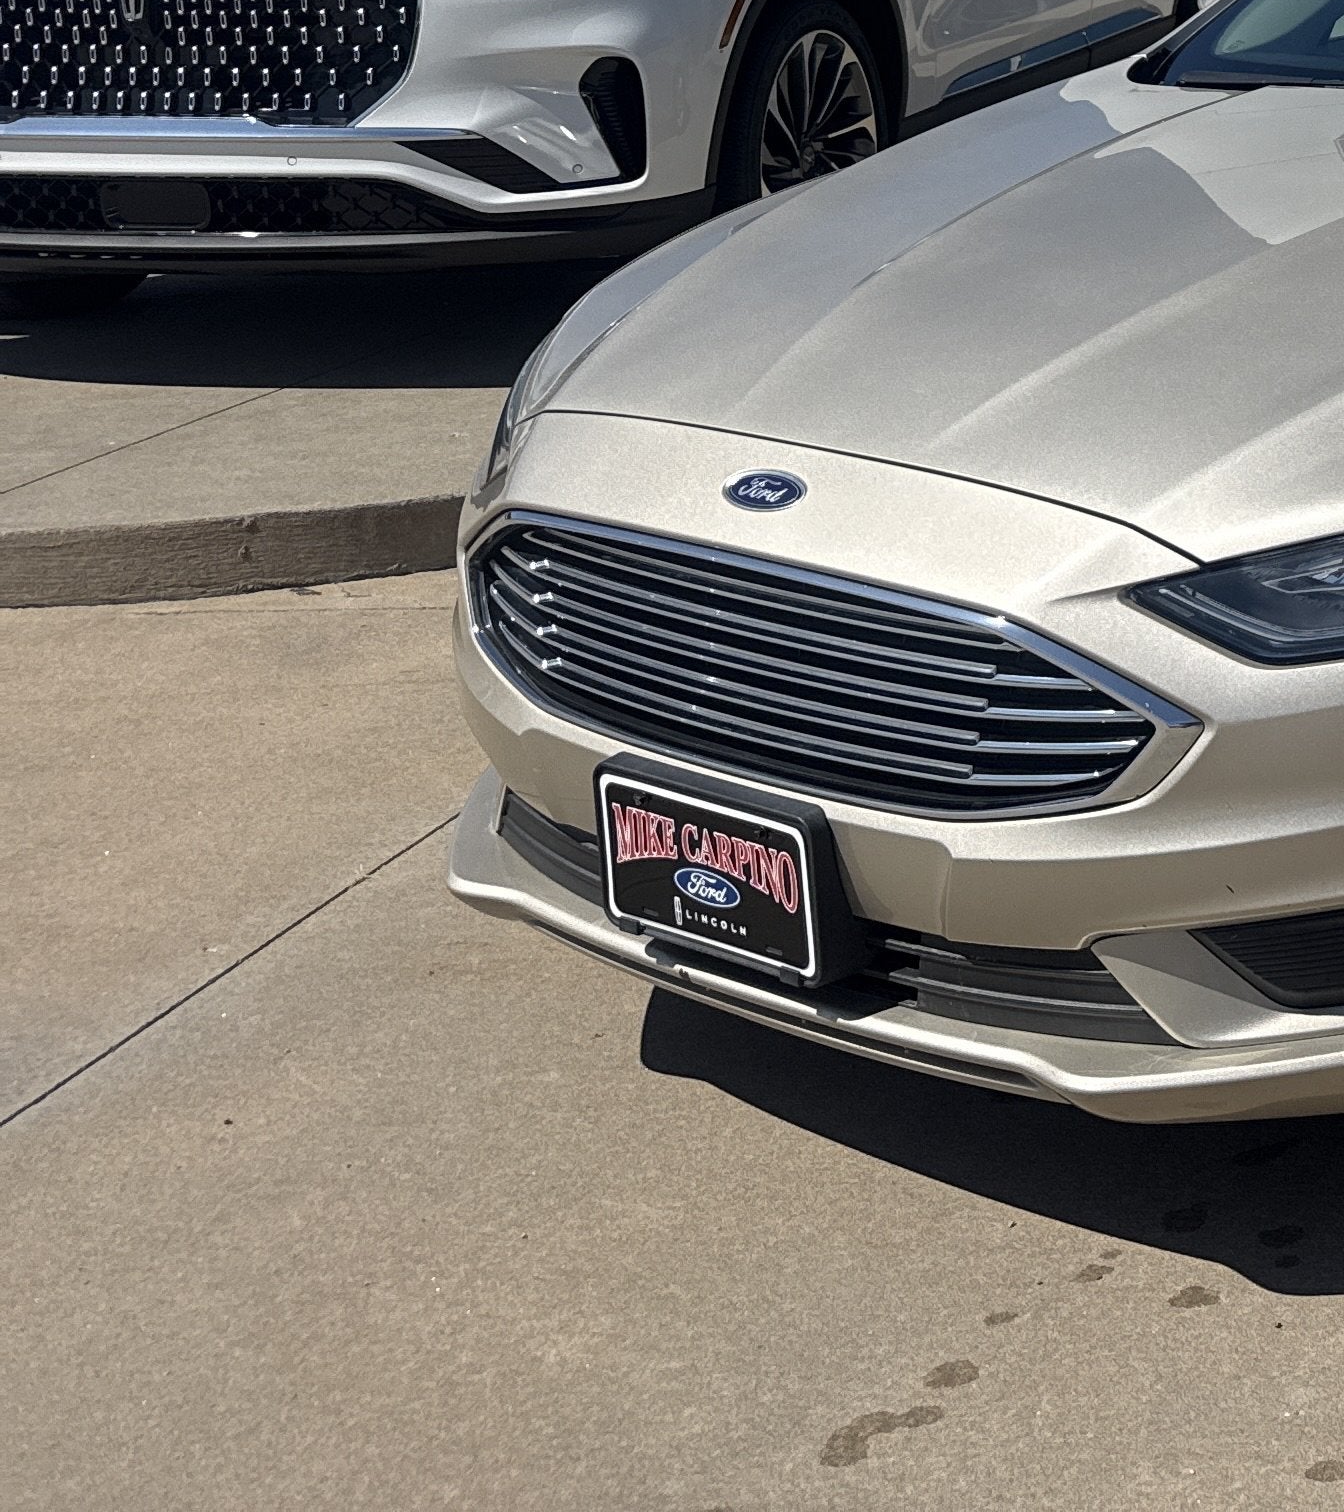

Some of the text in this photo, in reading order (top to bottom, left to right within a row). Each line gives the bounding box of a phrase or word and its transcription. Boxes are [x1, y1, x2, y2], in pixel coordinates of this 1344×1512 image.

[737, 476, 789, 503] Ford
[611, 801, 798, 915] MIKE CARPINO
[686, 872, 728, 905] Ford
[685, 908, 748, 937] LINCOLN
